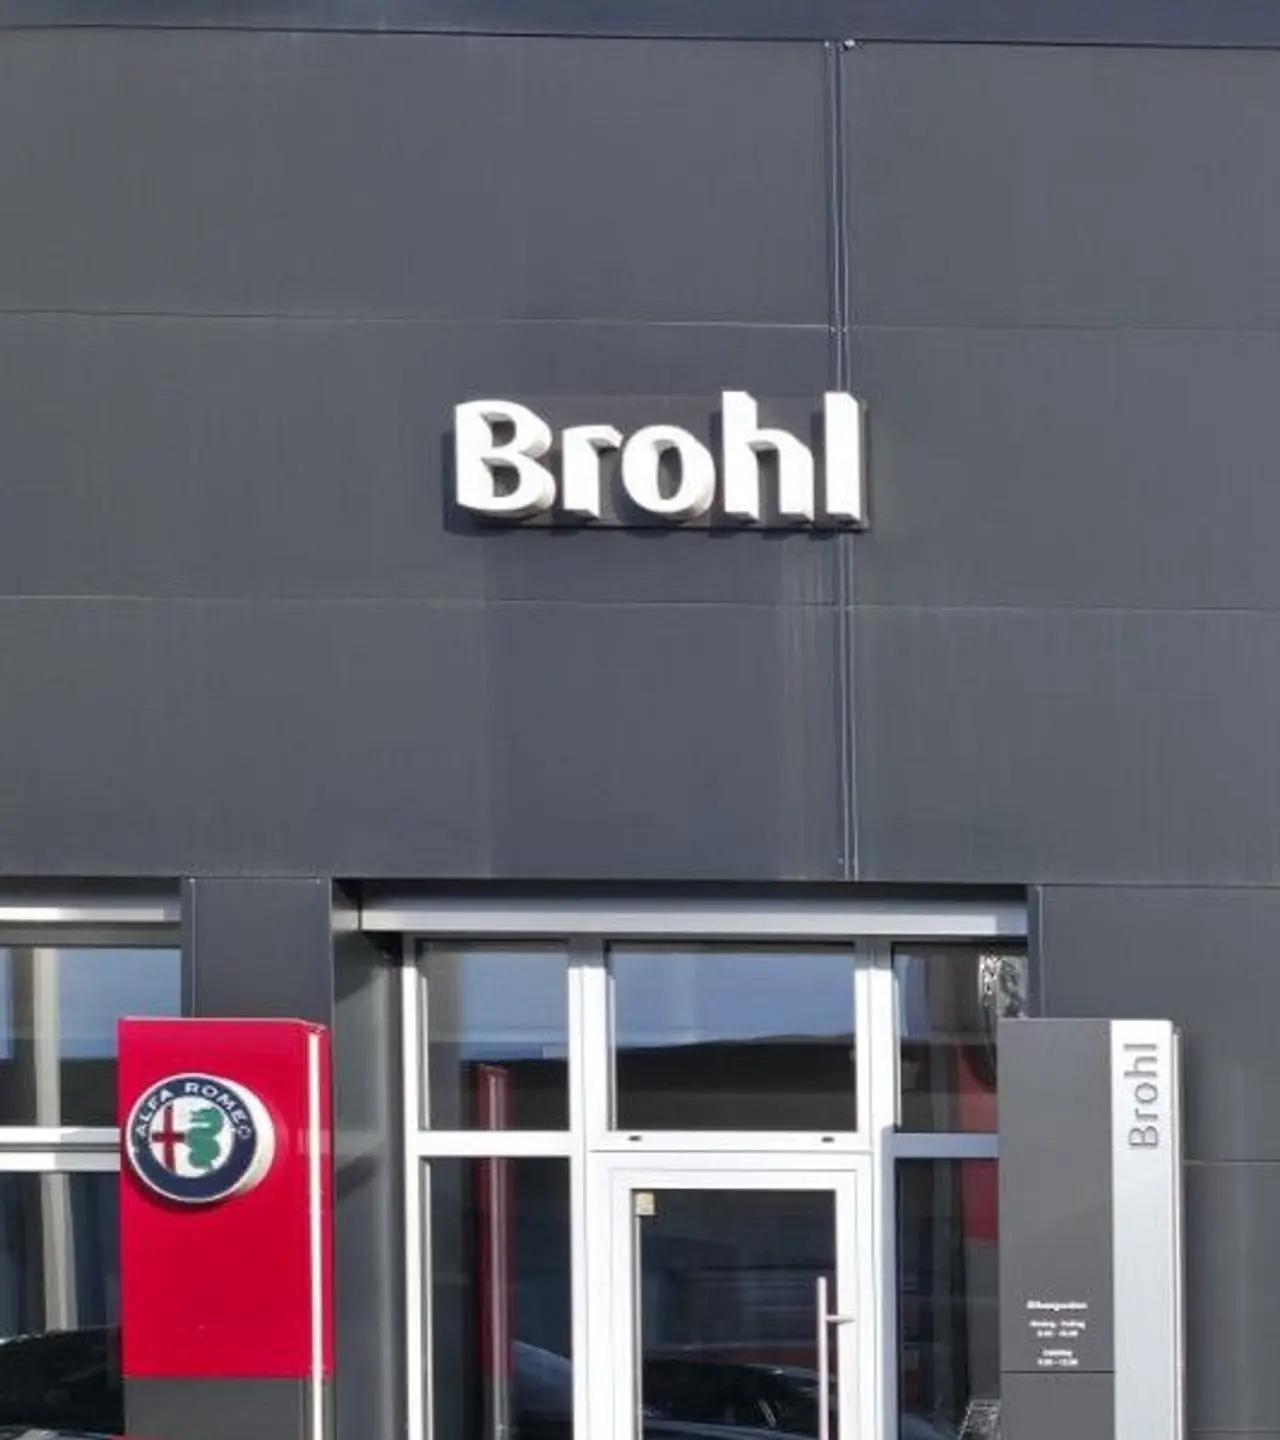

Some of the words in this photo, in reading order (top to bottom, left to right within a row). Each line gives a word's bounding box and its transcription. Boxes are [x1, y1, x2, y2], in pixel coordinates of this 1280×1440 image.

[455, 391, 862, 519] Brohl
[135, 1089, 174, 1137] ALFA
[184, 1082, 251, 1140] ROMEO
[1123, 1043, 1158, 1147] Brohl
